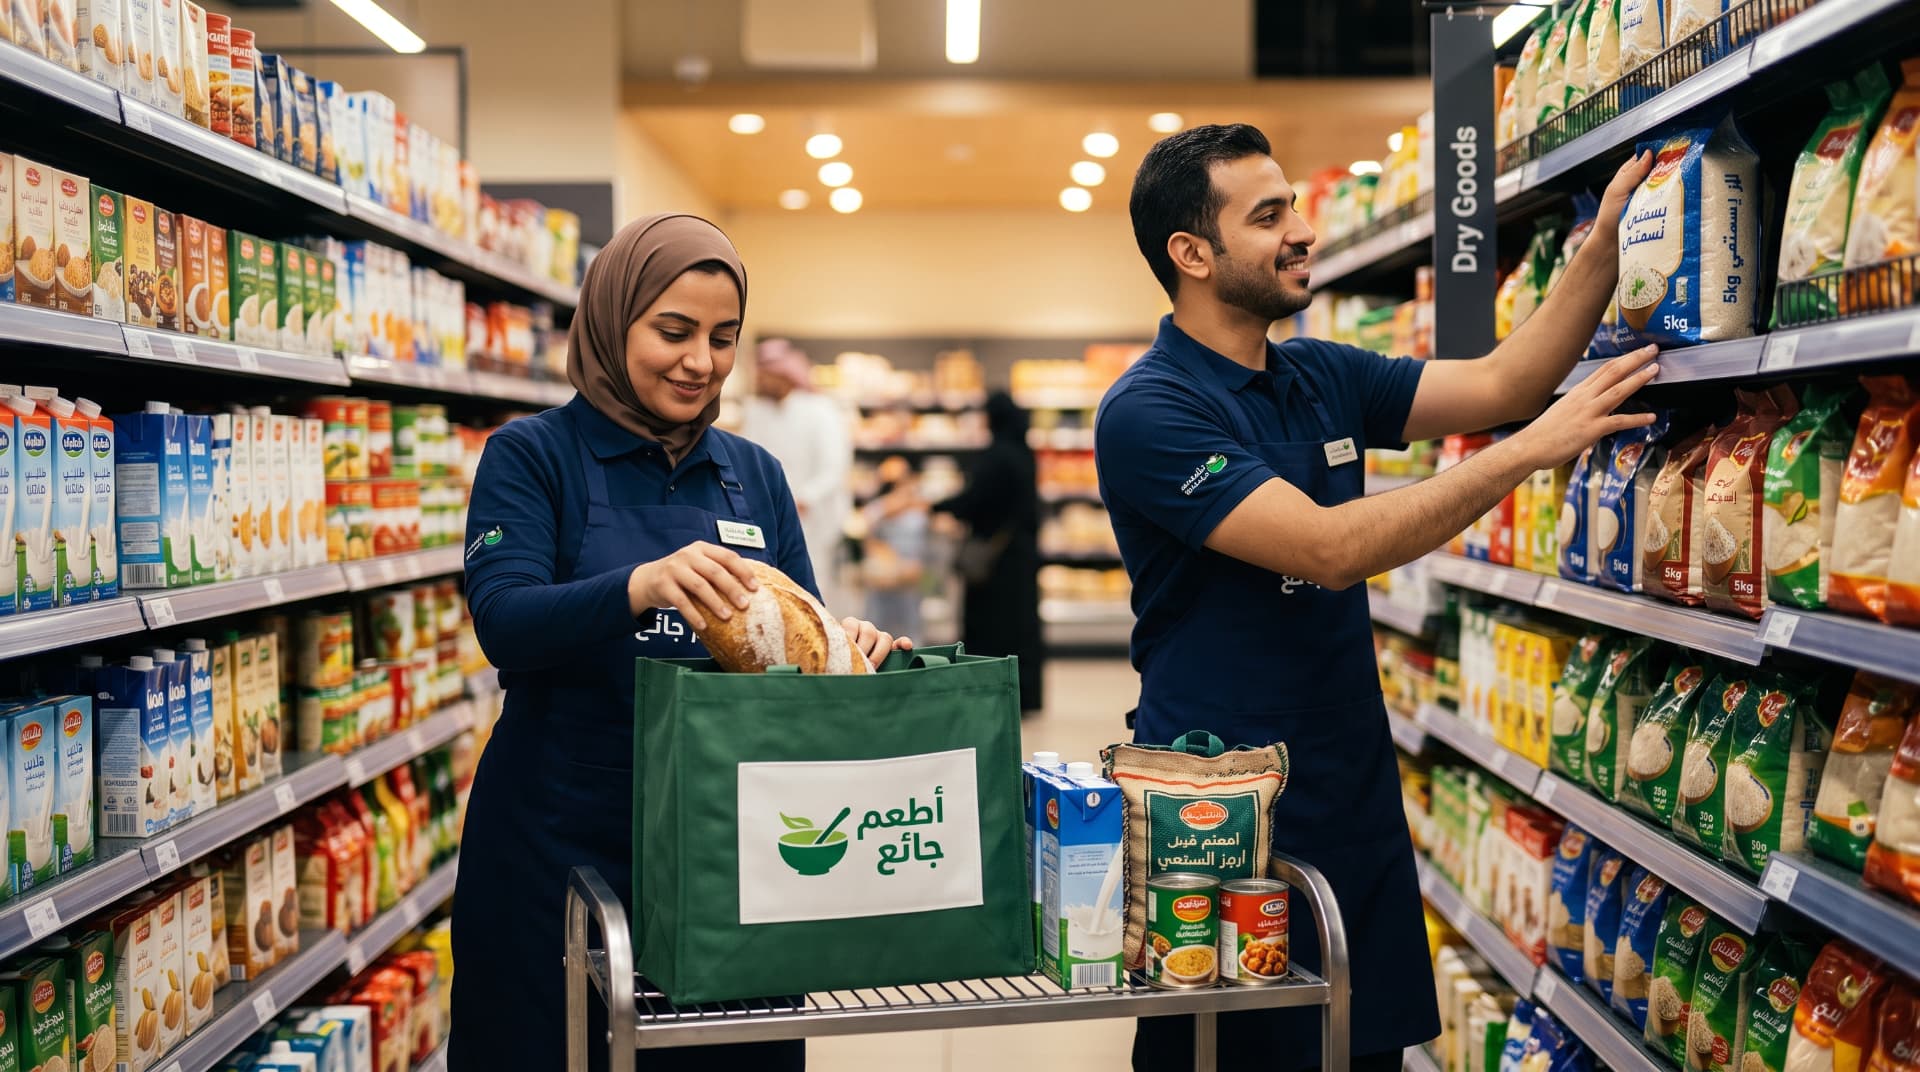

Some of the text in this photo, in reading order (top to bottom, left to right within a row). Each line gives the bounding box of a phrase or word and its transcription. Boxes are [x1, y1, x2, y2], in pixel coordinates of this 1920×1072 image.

[1450, 126, 1484, 273] Dry Goods
[1723, 275, 1742, 304] 5kg
[1663, 314, 1688, 333] 5kg
[1613, 558, 1629, 574] 5kg
[1664, 567, 1682, 581] 5kg
[1733, 579, 1754, 594] 5kg
[857, 785, 944, 840] أطعم
[876, 832, 945, 876] جائع
